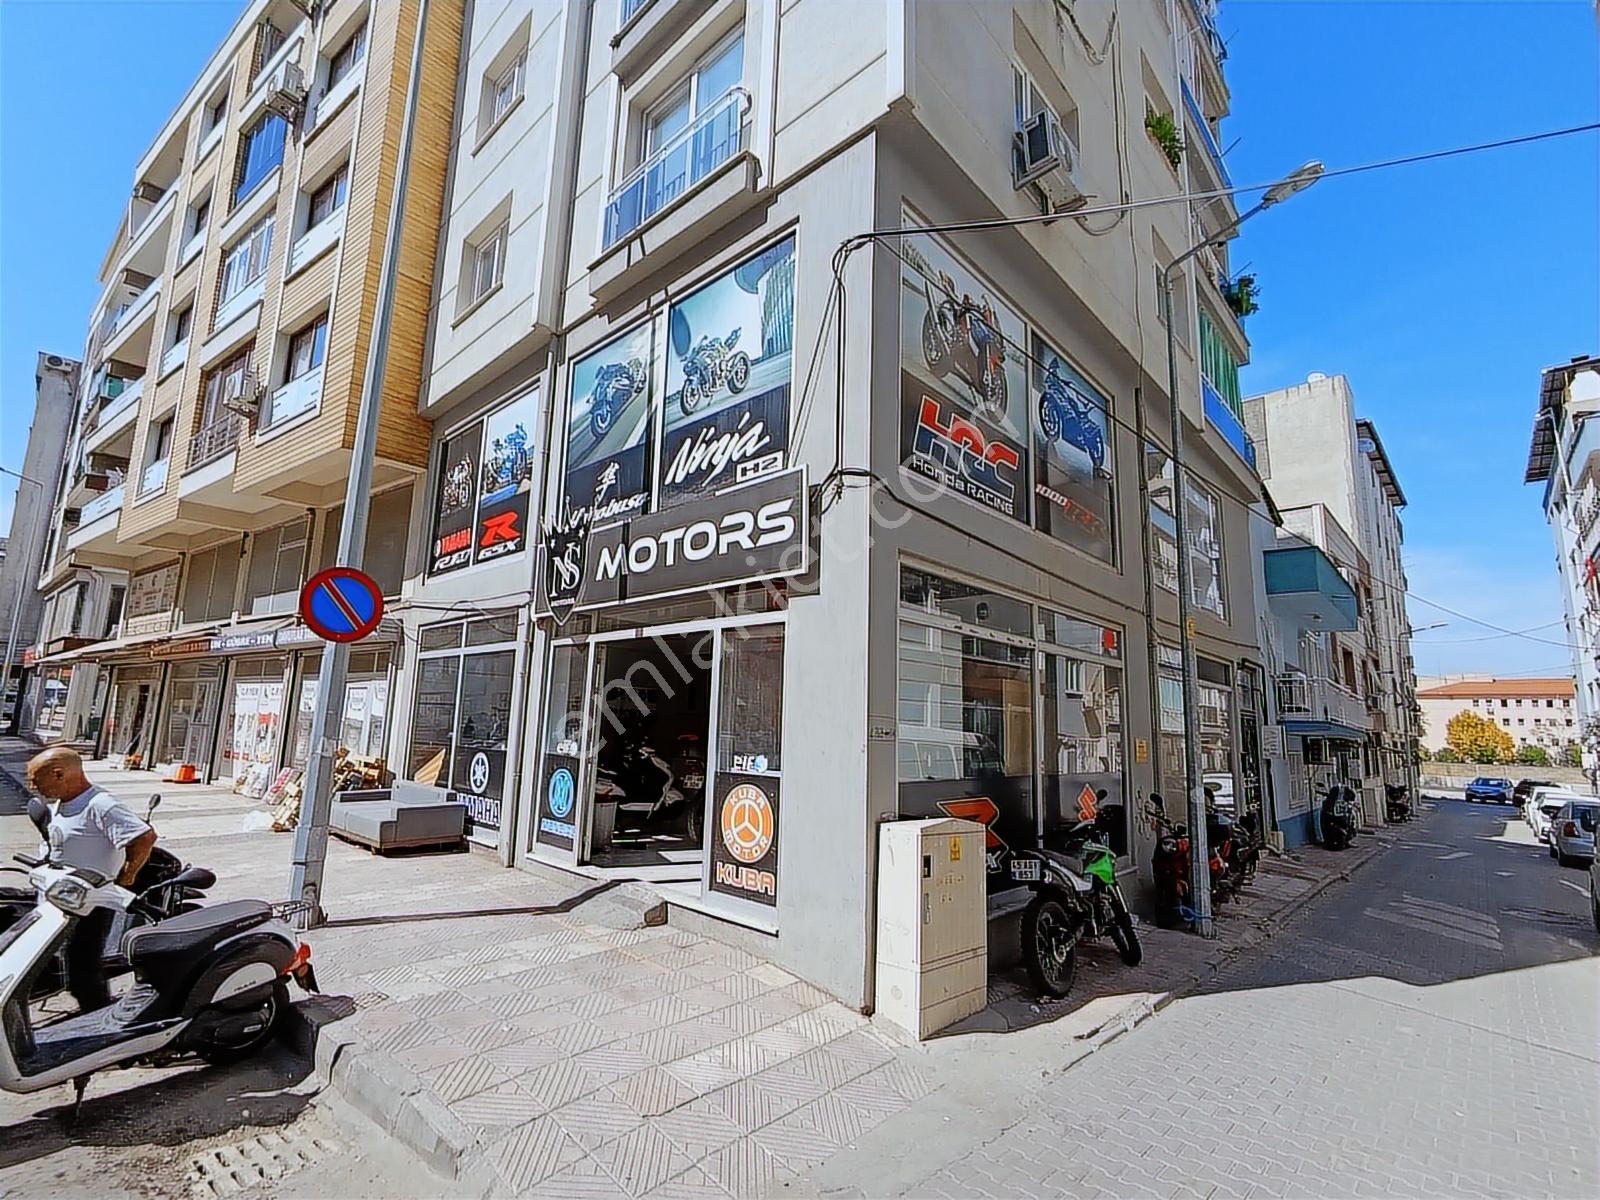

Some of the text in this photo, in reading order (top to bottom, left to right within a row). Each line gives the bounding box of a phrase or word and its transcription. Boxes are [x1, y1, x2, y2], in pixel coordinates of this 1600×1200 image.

[664, 411, 770, 488] Ninja
[738, 454, 781, 479] H2
[912, 394, 1020, 503] HRC
[912, 455, 1015, 516] Honda RACING
[594, 498, 797, 582] MOTORS
[729, 787, 766, 810] KUBA
[716, 861, 776, 896] KUBA
